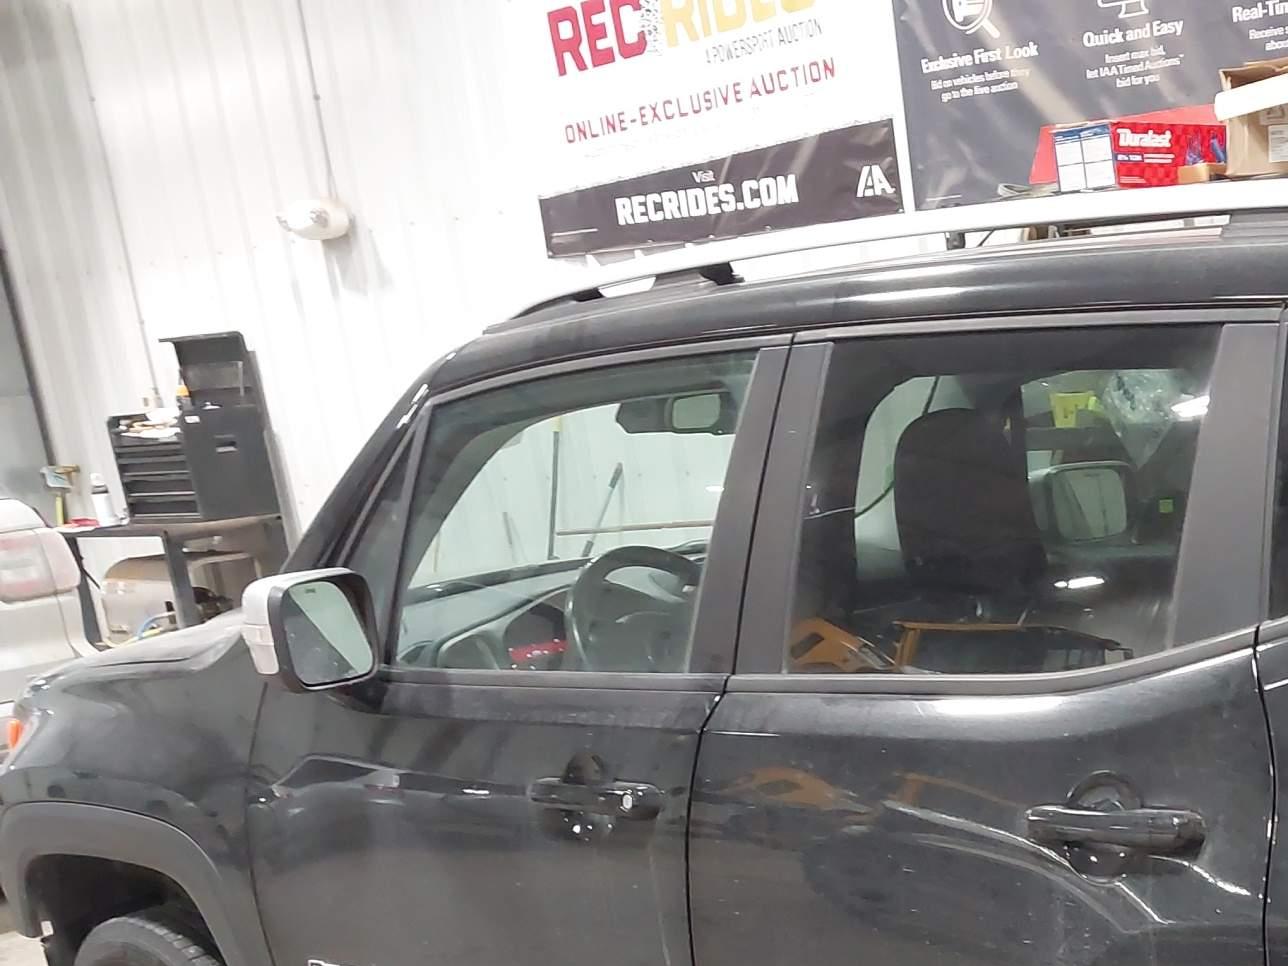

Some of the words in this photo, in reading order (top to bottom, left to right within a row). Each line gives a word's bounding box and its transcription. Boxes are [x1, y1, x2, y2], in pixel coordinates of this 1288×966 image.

[660, 0, 818, 48] RID
[1083, 28, 1124, 47] Quick
[1126, 22, 1150, 41] and
[1152, 20, 1183, 36] Easy
[1005, 41, 1039, 60] Look
[565, 82, 743, 144] ONLINE-EXCLUSIVE
[750, 57, 836, 98] AUCTION
[1116, 128, 1172, 148] Duralast
[615, 174, 799, 226] RECRIDES.COM
